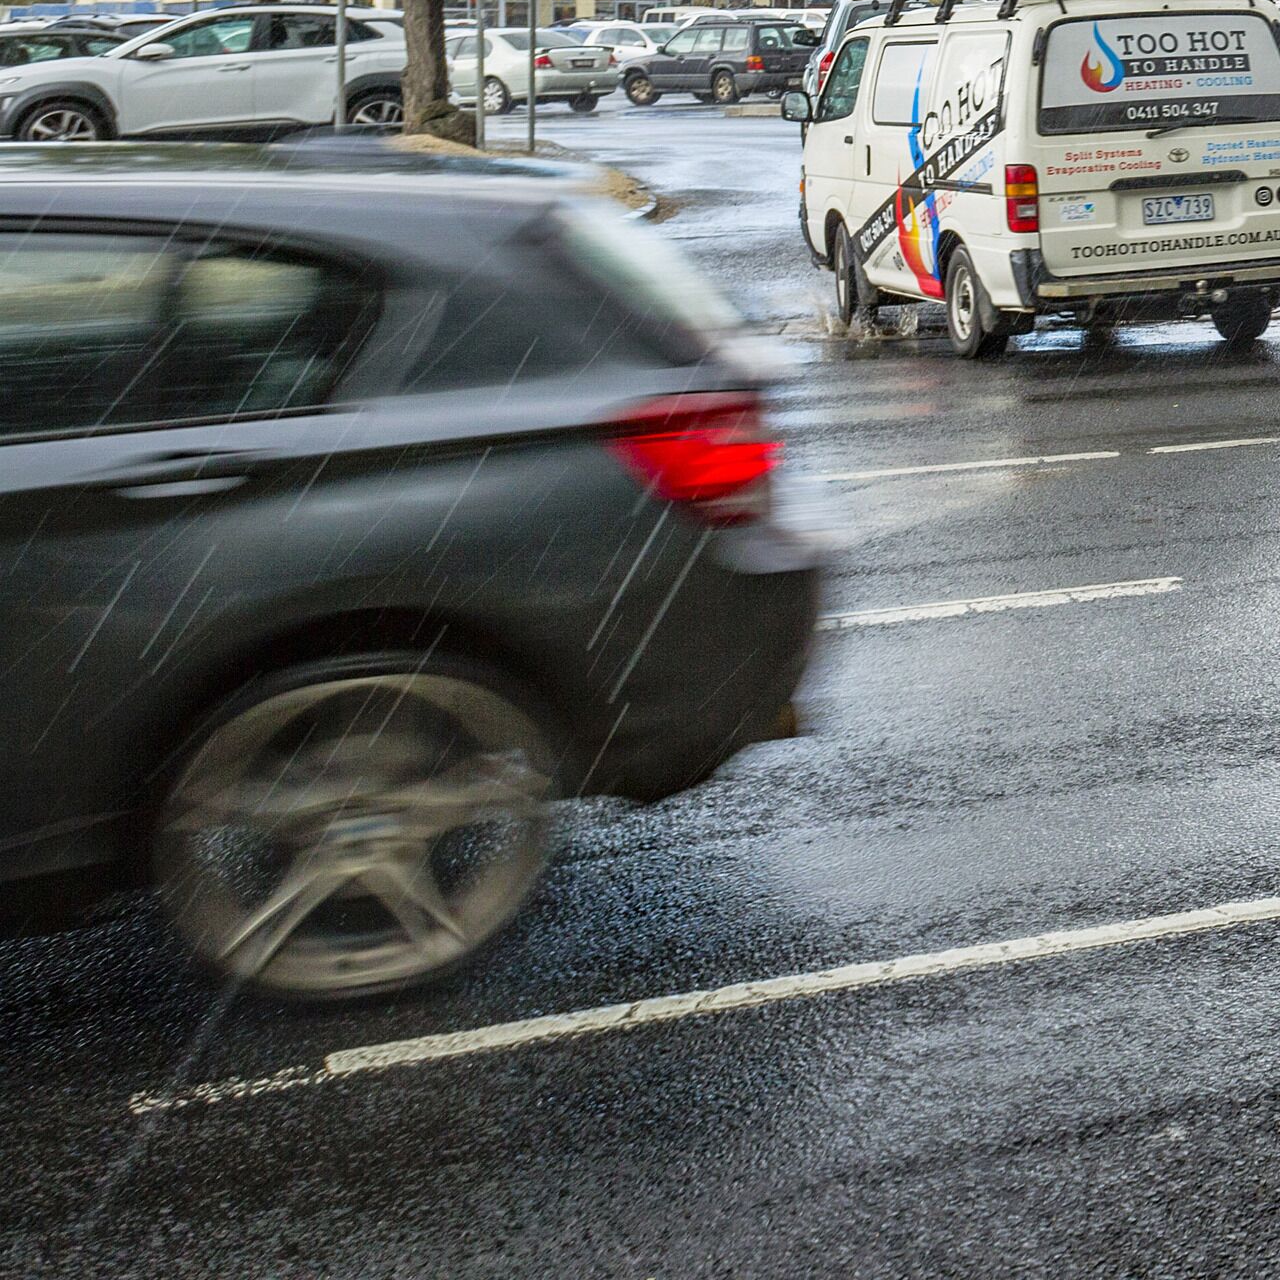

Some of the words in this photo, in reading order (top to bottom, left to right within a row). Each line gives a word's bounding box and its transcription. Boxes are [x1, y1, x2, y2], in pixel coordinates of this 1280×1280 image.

[1117, 34, 1179, 55] TOO
[1186, 31, 1246, 52] HOT
[1129, 61, 1156, 74] TO
[1165, 56, 1246, 71] HANDLE
[1124, 79, 1183, 92] HEATING
[1196, 75, 1253, 87] COOLING
[1126, 104, 1158, 120] 0411
[1162, 103, 1190, 117] 504
[1193, 102, 1219, 116] 347
[1208, 140, 1245, 152] Ducted
[1064, 151, 1094, 163] Split
[1096, 148, 1143, 160] Systems
[1202, 153, 1251, 165] Hydronic
[1047, 163, 1116, 176] Evaporative
[1118, 160, 1162, 172] Cooling
[1145, 201, 1174, 217] SZC
[1185, 198, 1211, 215] 739
